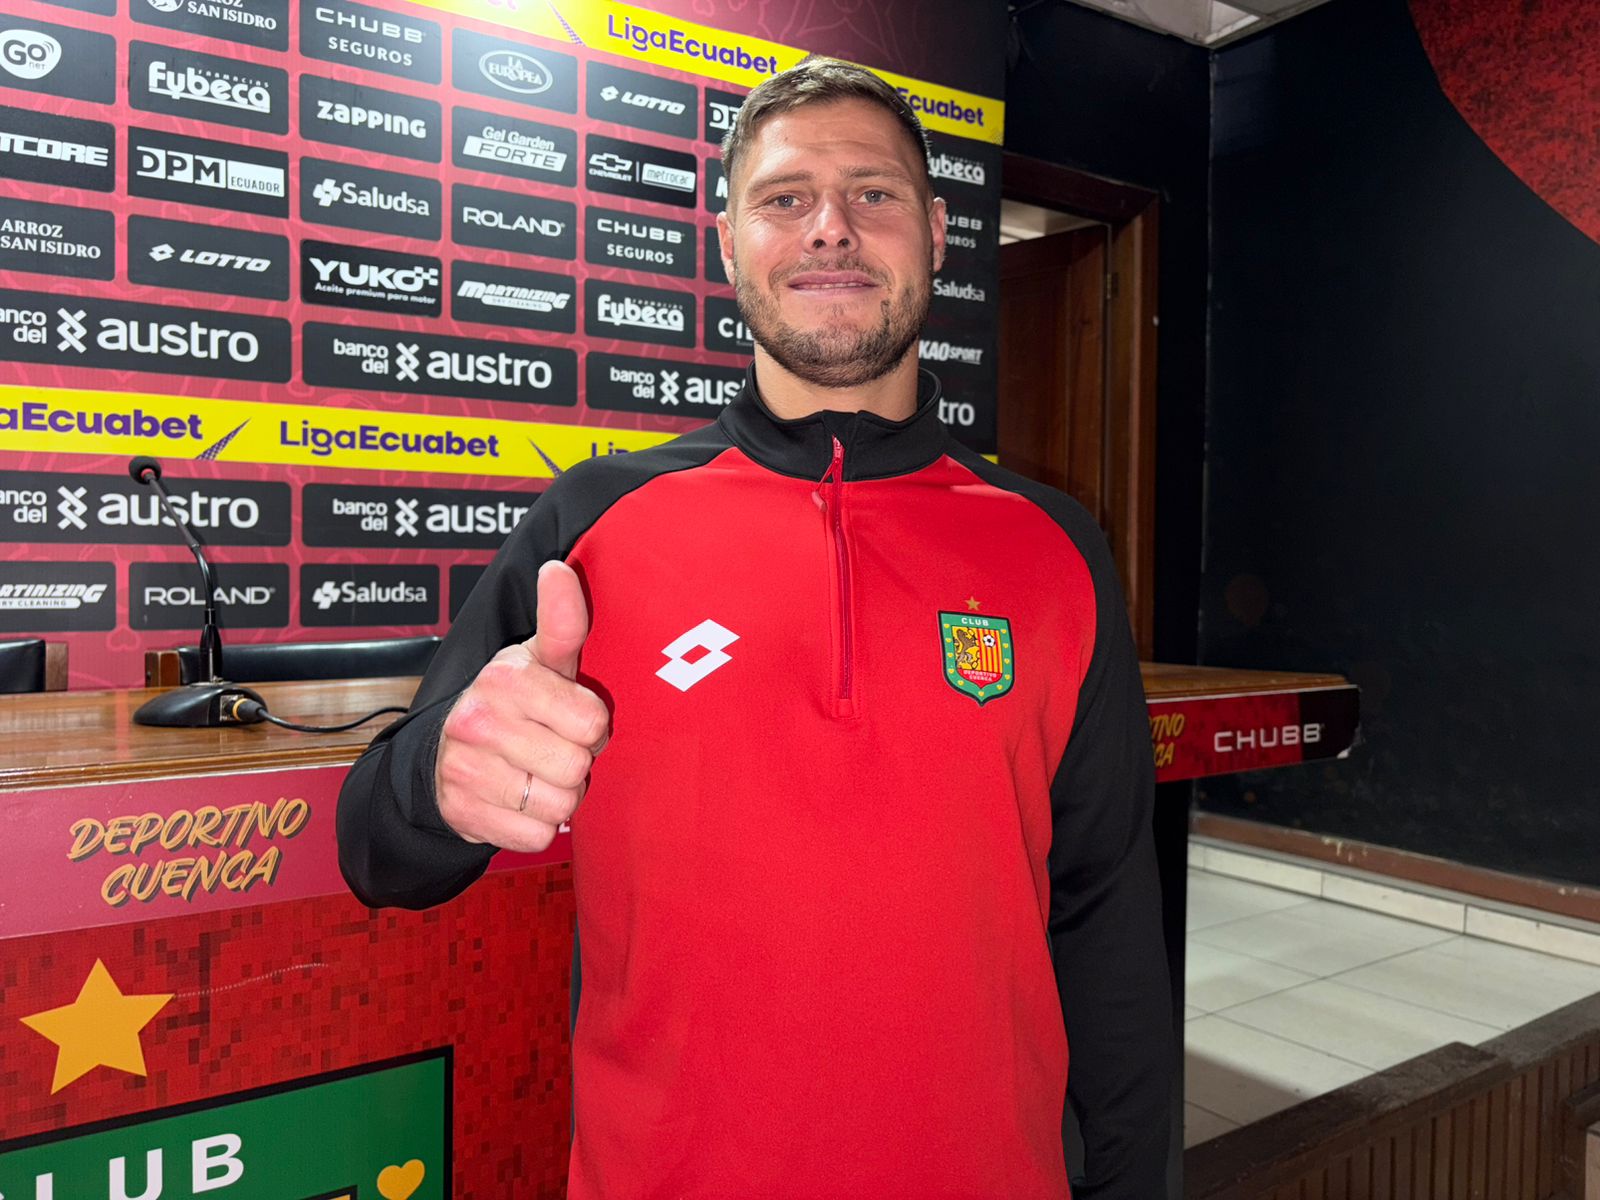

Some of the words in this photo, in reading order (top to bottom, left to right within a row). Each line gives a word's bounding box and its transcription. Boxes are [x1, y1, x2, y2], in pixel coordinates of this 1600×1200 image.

[187, 1, 220, 18] SAN
[222, 8, 276, 30] ISIDRO
[316, 7, 423, 43] CHUBB
[328, 36, 412, 66] SEGUROS
[608, 14, 778, 74] LigaEcuabet
[621, 92, 686, 115] LOTTO
[0, 131, 109, 166] TCORE
[482, 126, 505, 141] Gel
[507, 131, 555, 151] Garden
[136, 145, 227, 189] DPM
[230, 176, 281, 193] ECUADOR
[478, 143, 559, 169] FORTE
[928, 154, 985, 183] ybeca
[342, 183, 430, 216] Saludsa
[0, 219, 63, 239] ARROZ
[463, 206, 562, 237] ROLAND
[597, 218, 682, 244] CHUBB
[944, 214, 982, 231] UBB
[0, 236, 37, 252] SAN
[40, 240, 101, 259] ISIDRO
[180, 249, 271, 272] LOTTO
[607, 244, 674, 265] SEGUROS
[309, 257, 425, 292] YUKO
[346, 287, 386, 299] premium
[932, 278, 985, 302] Saludsa
[13, 325, 47, 344] del
[97, 317, 259, 363] austro
[333, 338, 388, 359] banco
[361, 357, 389, 375] del
[426, 350, 552, 389] austro
[610, 366, 655, 385] banco
[632, 383, 655, 399] del
[685, 377, 746, 405] aus
[0, 402, 203, 440] aEcuabet
[937, 397, 976, 427] tro
[280, 420, 499, 457] LigaEcuabet
[13, 505, 47, 523] del
[97, 490, 259, 529] austro
[332, 498, 388, 516] banco
[361, 514, 388, 531] del
[426, 501, 530, 534] austr
[341, 582, 427, 603] Saludsa
[961, 617, 989, 627] CLUB
[1213, 723, 1322, 752] CHUBB
[66, 797, 311, 862] DEPORTIVO
[100, 846, 285, 908] CUENCA
